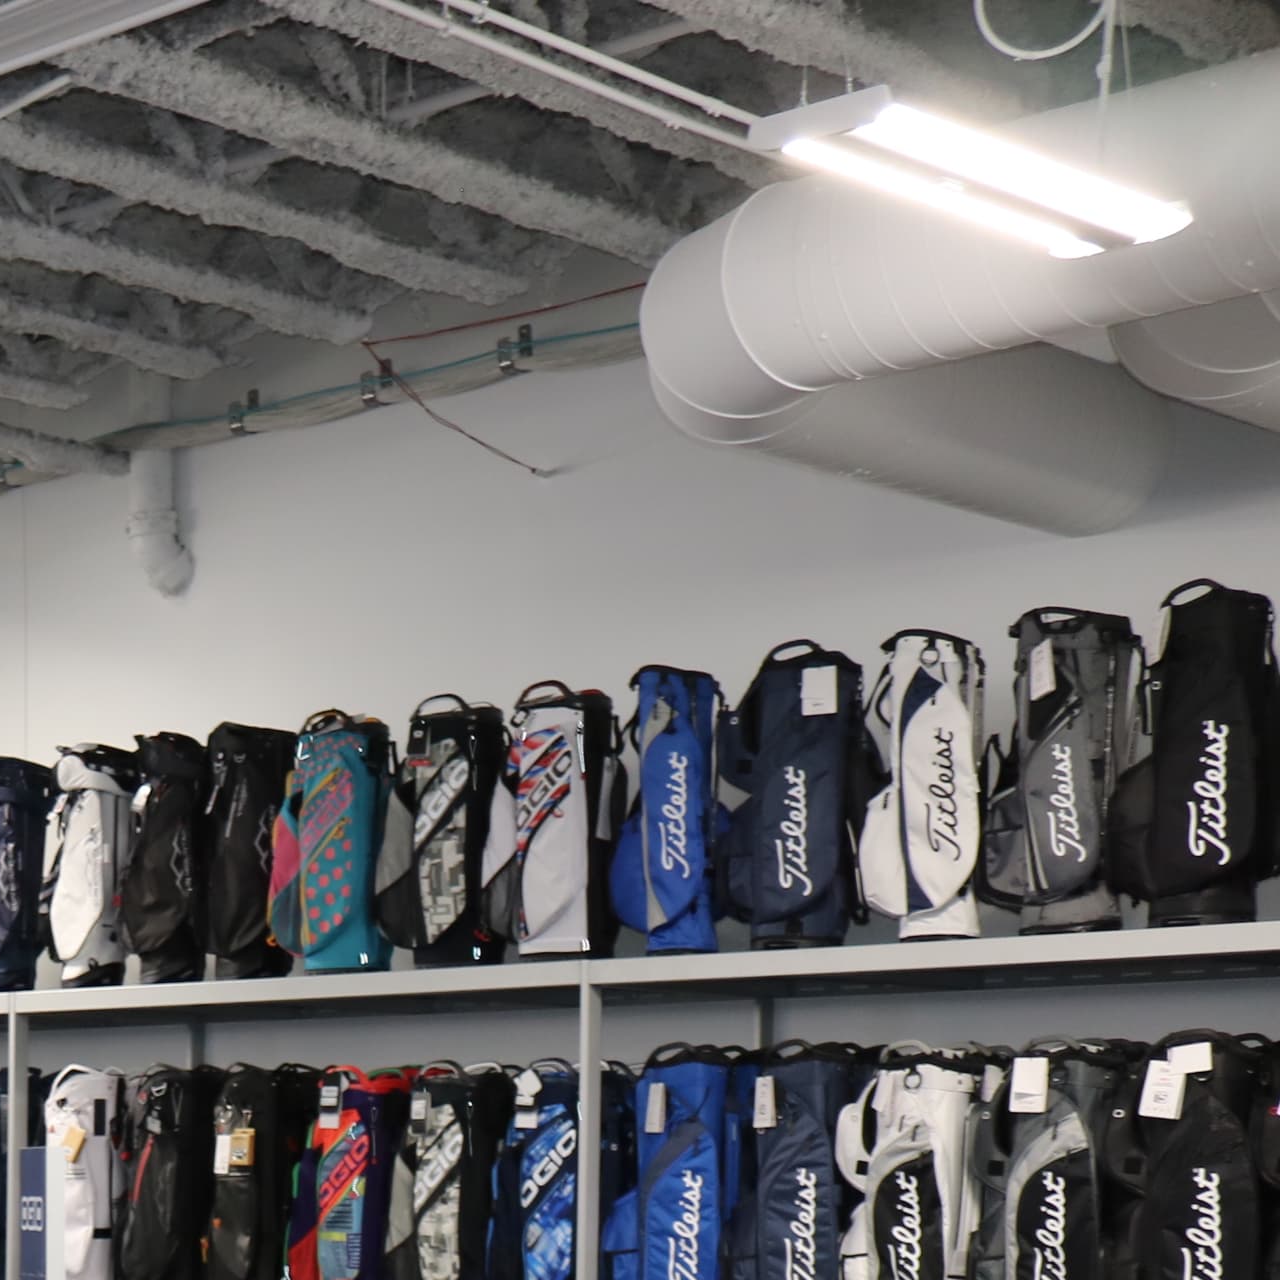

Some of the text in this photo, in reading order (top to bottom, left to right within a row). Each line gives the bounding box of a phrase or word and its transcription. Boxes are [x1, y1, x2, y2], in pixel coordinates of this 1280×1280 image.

[516, 750, 573, 831] OGIO
[661, 751, 694, 879] Titleist
[778, 765, 806, 896] Titleist
[924, 727, 959, 861] Titleist
[1051, 743, 1080, 863] Titleist
[1188, 720, 1231, 865] Titleist
[519, 1128, 577, 1209] OGIO
